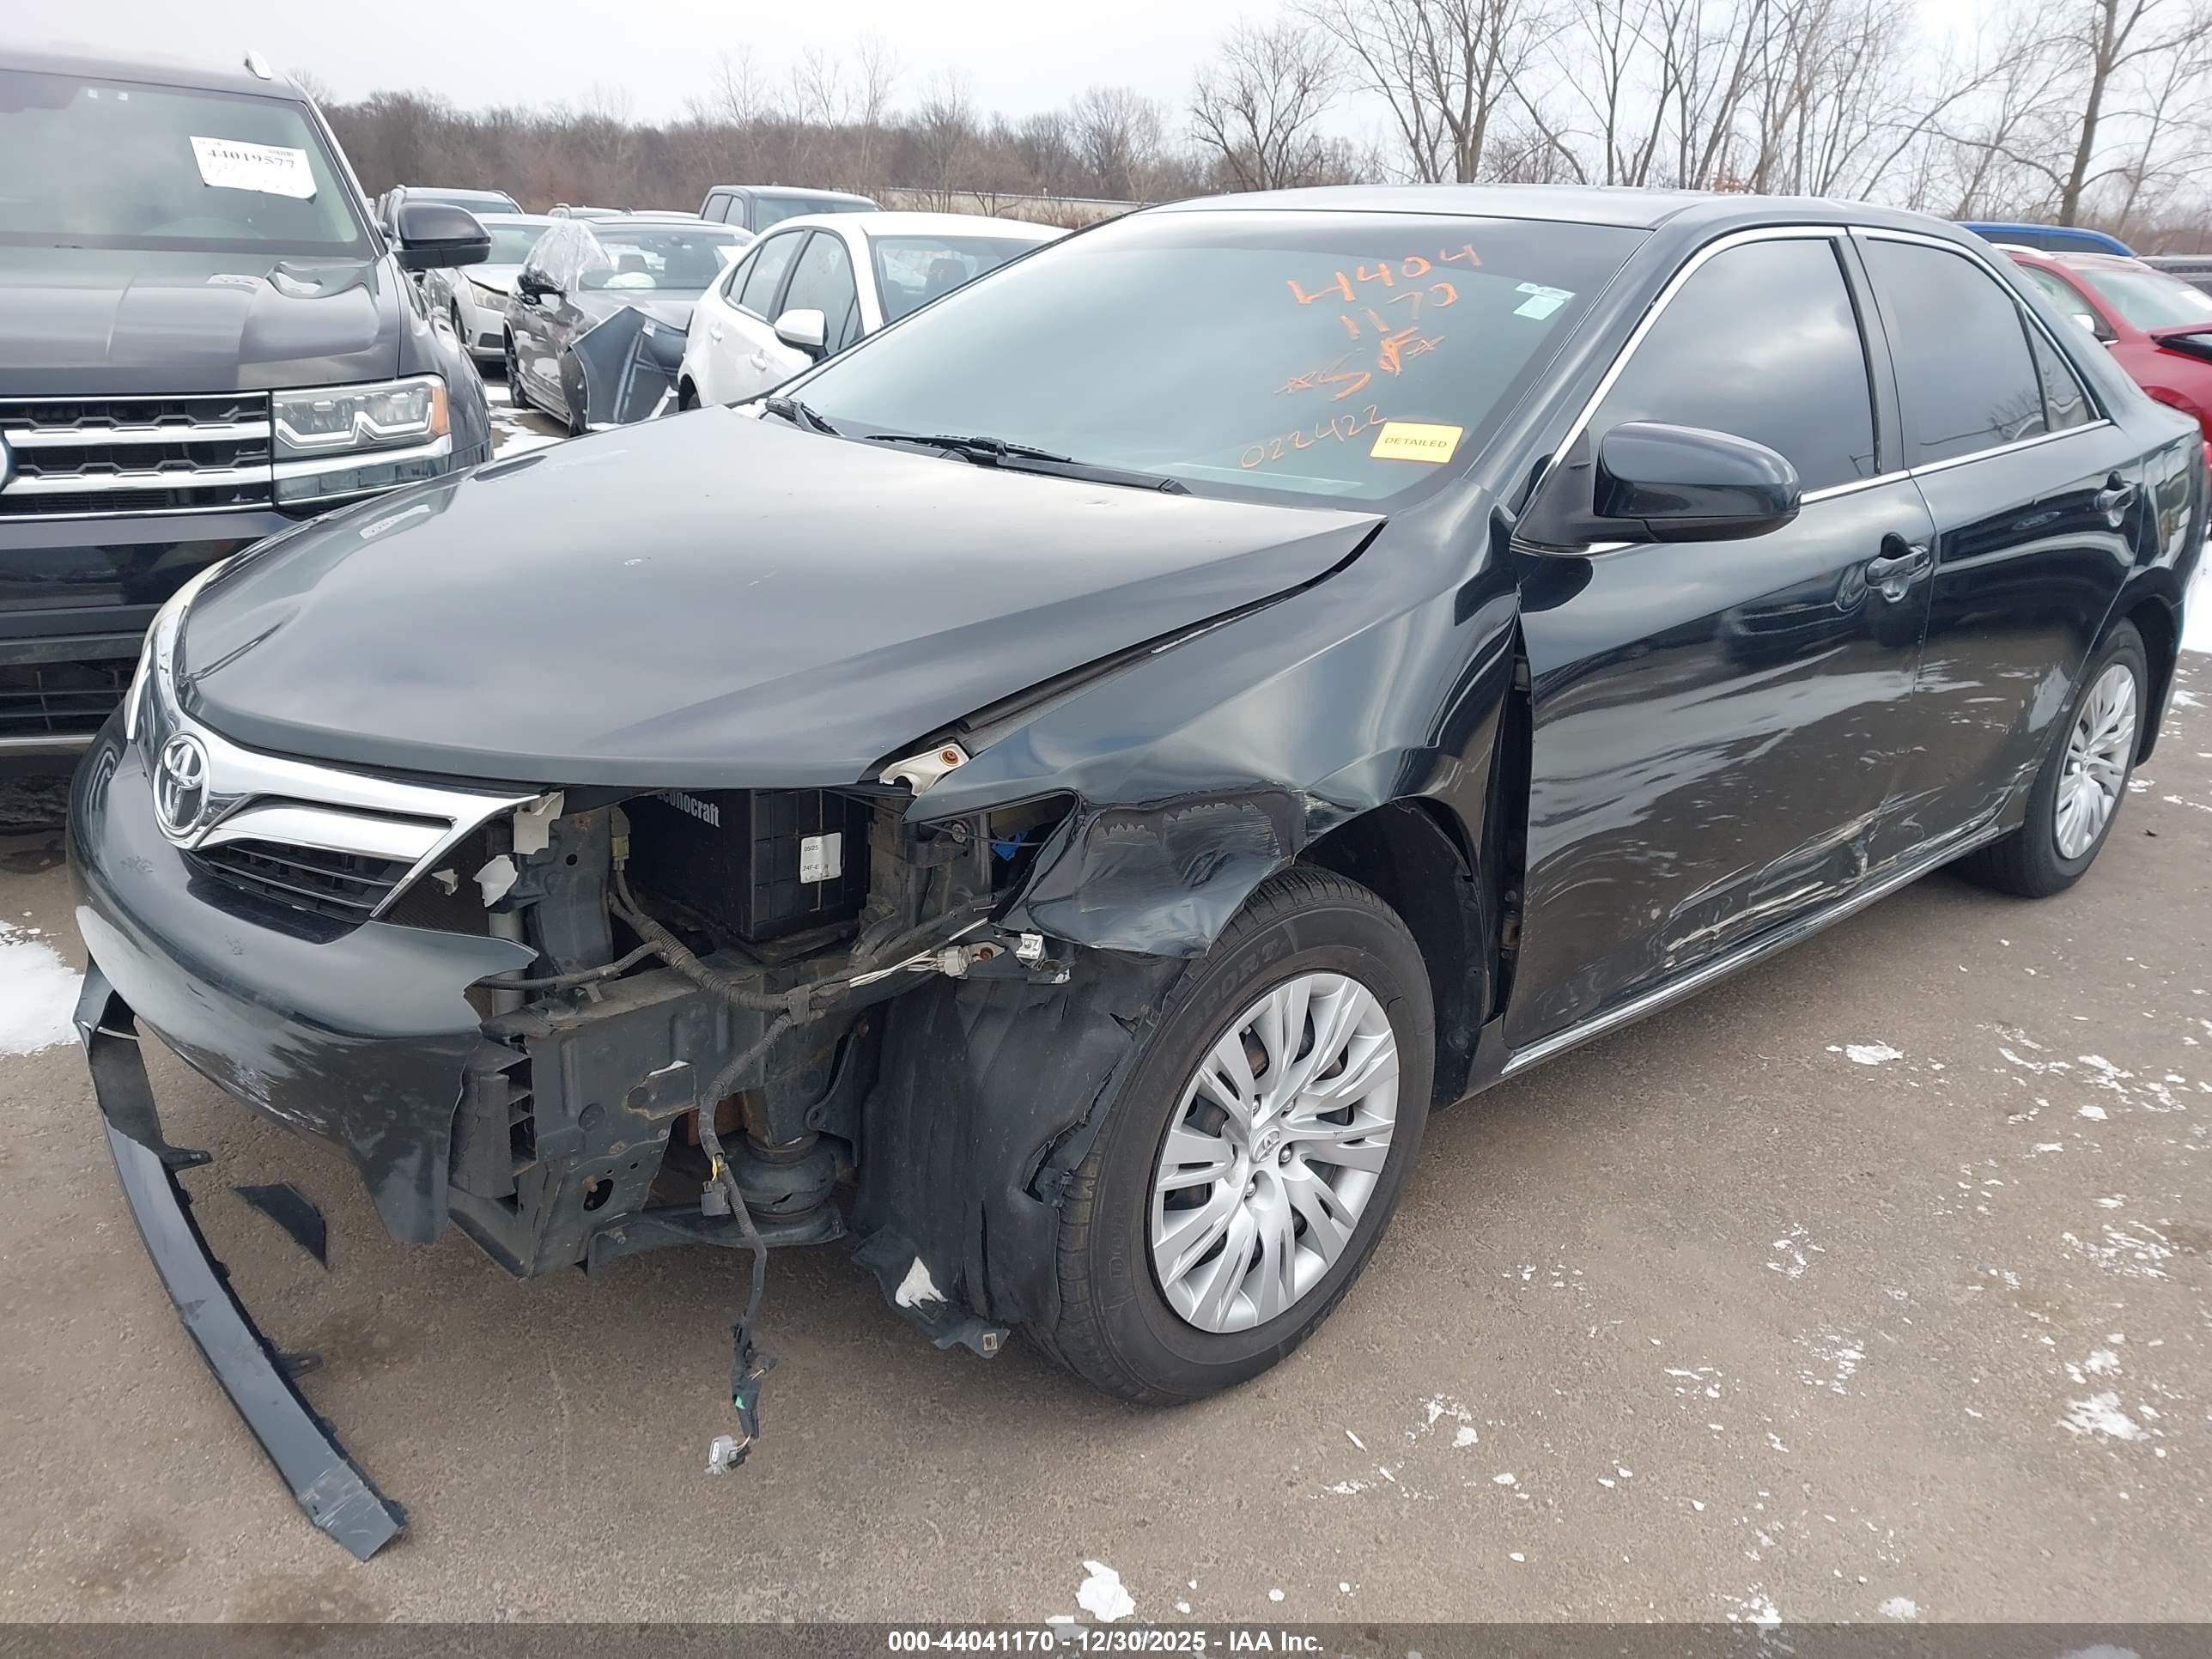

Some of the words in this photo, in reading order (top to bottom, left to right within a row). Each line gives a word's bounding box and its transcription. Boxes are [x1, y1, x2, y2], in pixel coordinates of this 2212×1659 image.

[1287, 245, 1483, 304] 4404
[1339, 283, 1457, 340] 1170
[1241, 404, 1387, 468] 022422
[1384, 436, 1448, 450] DETAILED
